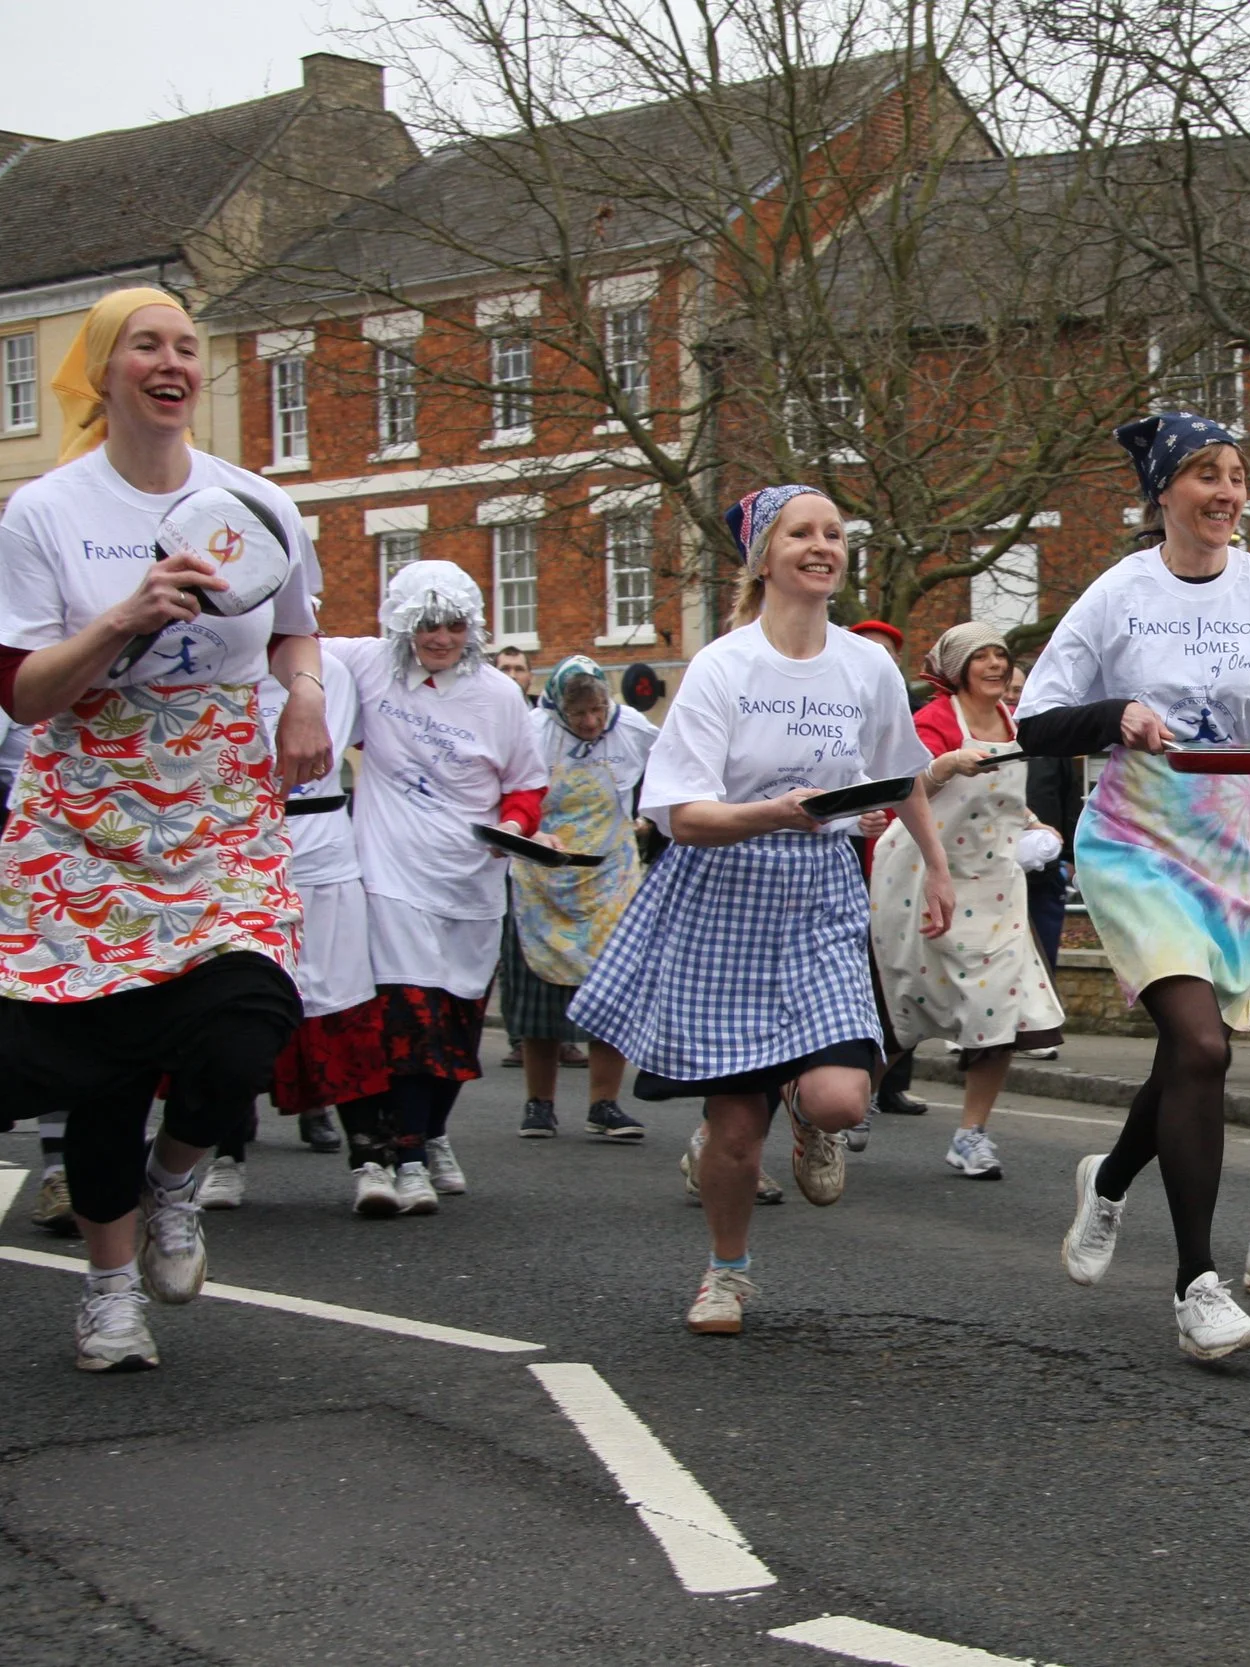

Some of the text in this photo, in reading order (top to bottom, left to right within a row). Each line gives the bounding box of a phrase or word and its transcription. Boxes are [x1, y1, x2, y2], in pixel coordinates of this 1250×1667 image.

[82, 540, 157, 560] FRANCIS
[1128, 617, 1191, 635] FRANCIS
[1184, 641, 1240, 655] HOMES
[1211, 657, 1223, 678] of
[378, 700, 423, 727] FRANCIS
[800, 696, 863, 719] JACKSON
[787, 723, 843, 738] HOMES
[412, 732, 455, 751] HOMES
[814, 742, 827, 763] of
